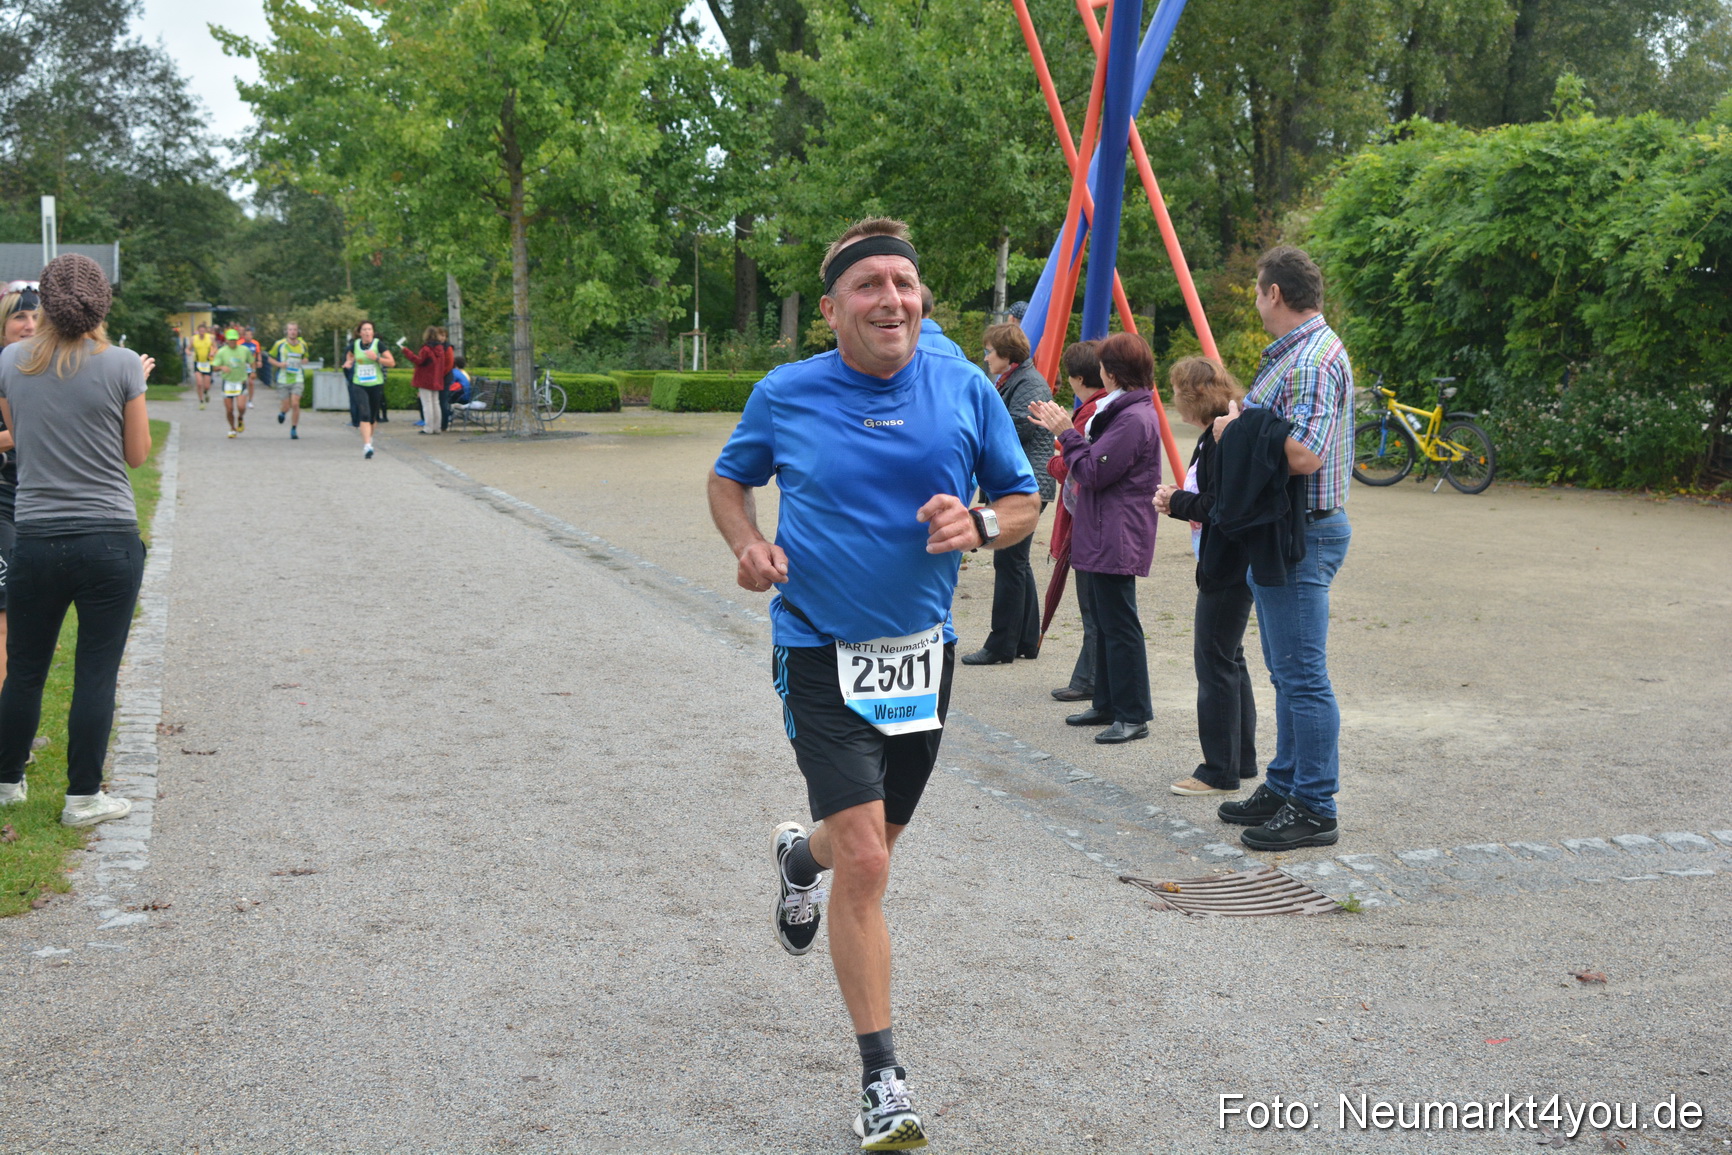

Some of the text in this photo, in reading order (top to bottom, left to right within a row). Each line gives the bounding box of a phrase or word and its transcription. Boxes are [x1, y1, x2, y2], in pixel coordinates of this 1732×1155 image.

[838, 638, 930, 654] PARTL Neumarkt
[851, 648, 931, 693] 2501
[874, 704, 918, 720] Werner
